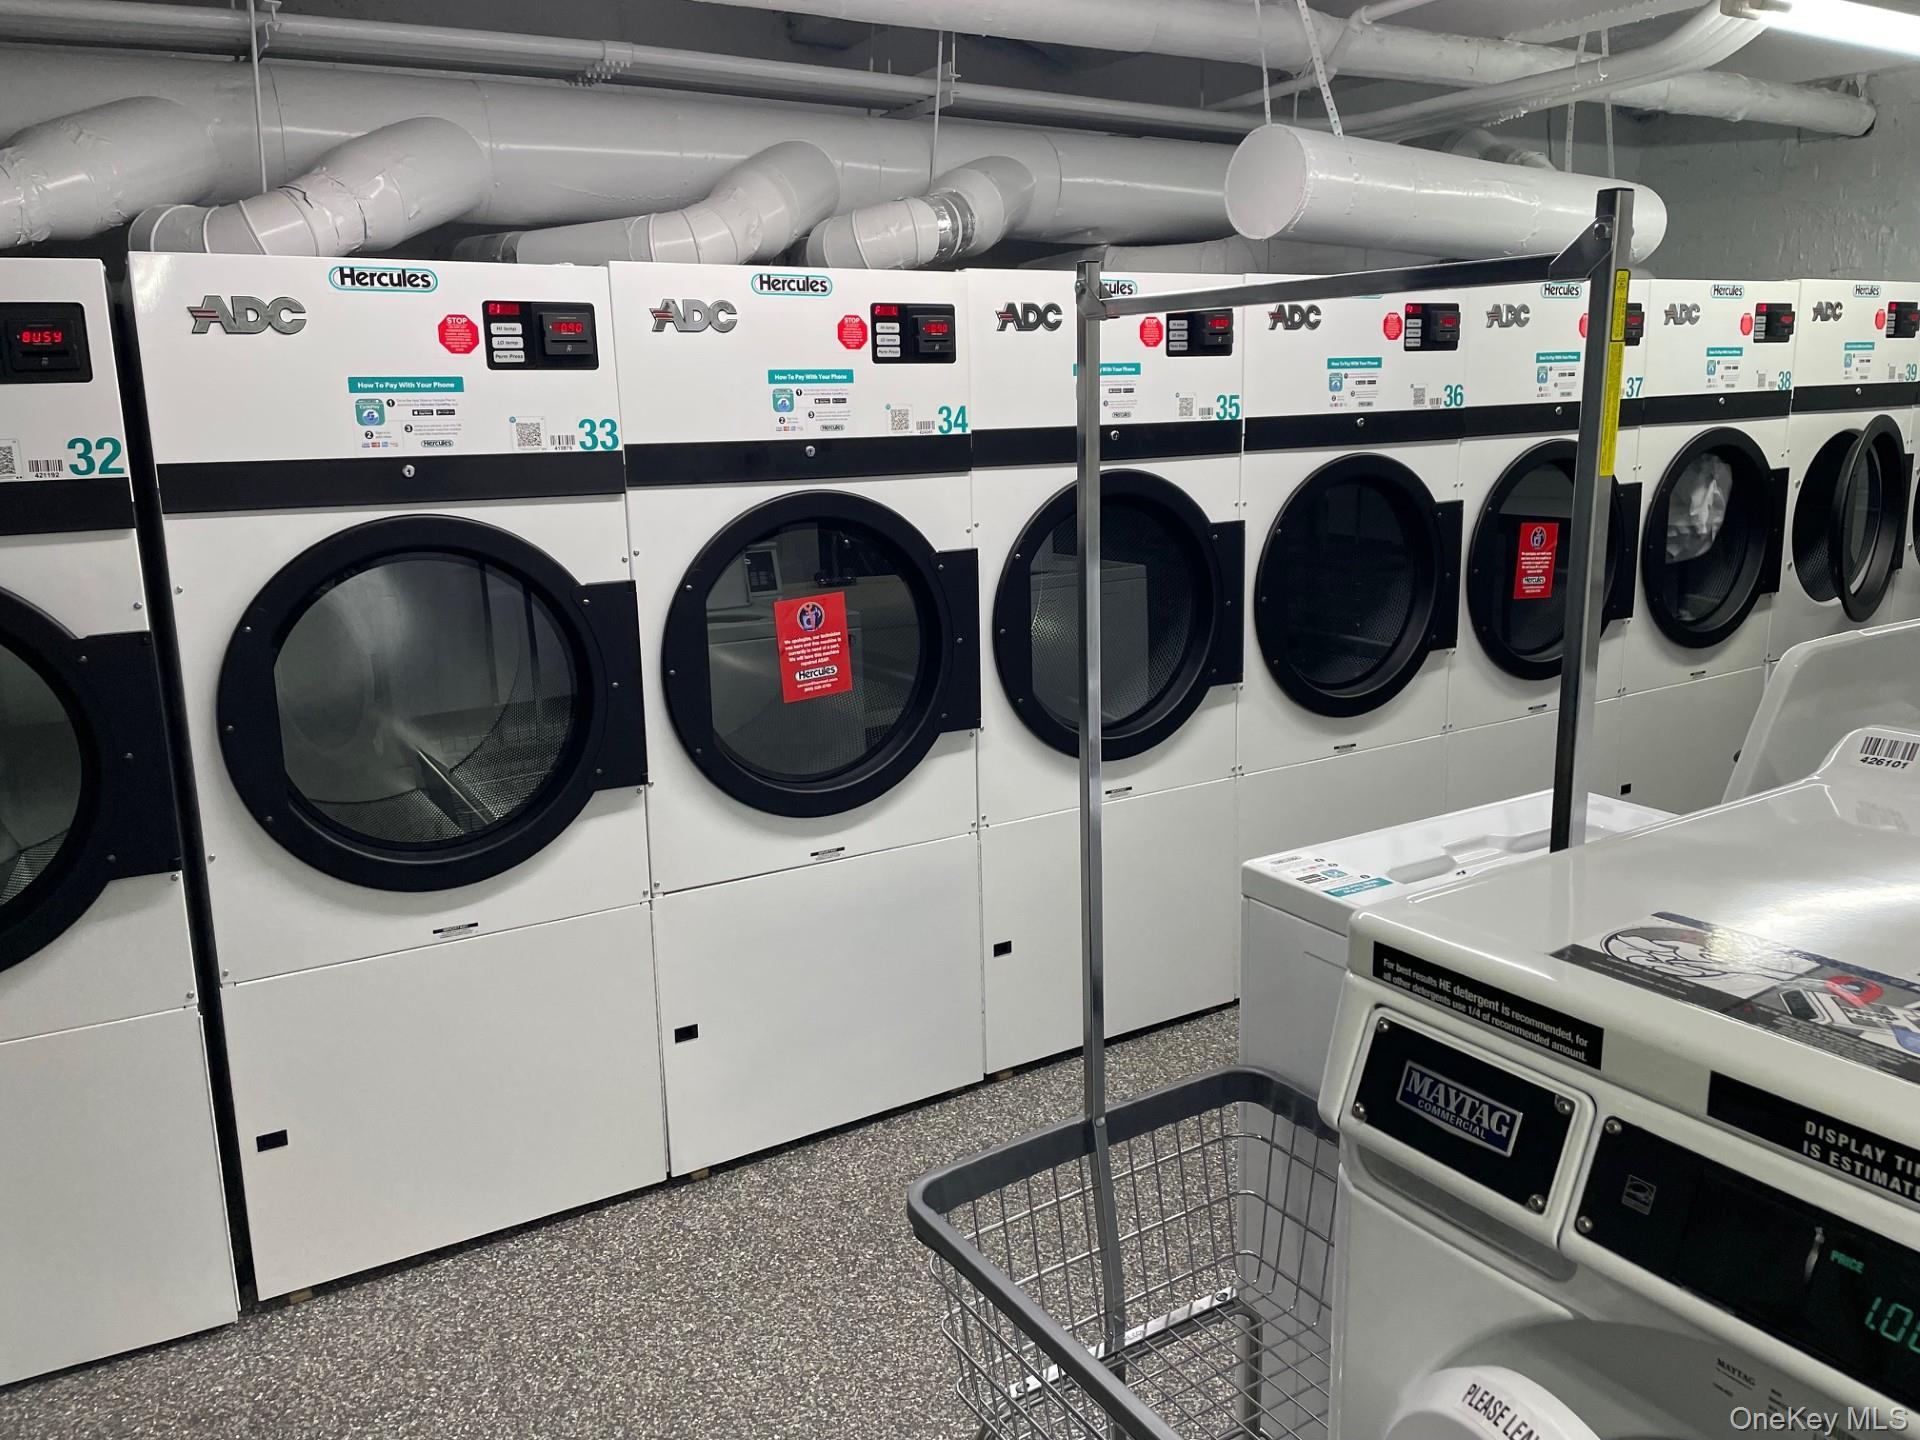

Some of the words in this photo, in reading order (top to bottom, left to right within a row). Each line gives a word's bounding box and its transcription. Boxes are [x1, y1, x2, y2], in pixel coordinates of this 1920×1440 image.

[338, 267, 432, 289] Hercules
[758, 275, 828, 293] Hercules
[1544, 284, 1580, 296] Hercules
[1713, 285, 1743, 296] Hercules
[1855, 285, 1880, 296] Hercules
[187, 295, 307, 335] ADC
[649, 298, 738, 333] ADC
[995, 302, 1064, 332] ADC
[1267, 303, 1322, 331] ADC
[1486, 303, 1531, 328] ADC
[1664, 303, 1701, 326] ADC
[1812, 301, 1843, 322] ADC
[22, 331, 62, 343] BUSY
[1778, 371, 1792, 390] 38
[1905, 364, 1918, 382] 39
[385, 382, 398, 390] Pay
[1443, 384, 1464, 407] 36
[1626, 377, 1643, 398] 37
[938, 405, 969, 434] 34
[1216, 394, 1240, 421] 35
[578, 418, 619, 450] 33
[67, 437, 125, 476] 32
[799, 667, 836, 680] Hercules
[1860, 756, 1909, 769] 426101
[1383, 958, 1396, 970] For
[1396, 962, 1412, 978] best
[1412, 968, 1438, 988] results
[1438, 978, 1452, 994] HE
[1453, 984, 1500, 1013] detergent
[1501, 1002, 1511, 1017] is
[1511, 1010, 1574, 1043] recommended,
[1576, 1034, 1589, 1048] for
[1383, 971, 1392, 982] all
[1392, 974, 1411, 990] other
[1412, 982, 1451, 1007] detergents
[1452, 1001, 1467, 1013] use
[1468, 1005, 1481, 1019] 1/4
[1482, 1011, 1490, 1022] of
[1491, 1016, 1550, 1046] recommended
[1551, 1041, 1588, 1063] amount.
[1405, 1069, 1511, 1137] MAYTAG
[1418, 1099, 1487, 1140] COMMERCIAL
[1802, 1140, 1822, 1159] IS
[1804, 1120, 1887, 1164] DISPLAY
[1829, 1249, 1865, 1275] PRICE
[1717, 1358, 1756, 1386] MAYTAG
[1462, 1383, 1511, 1427] PLEASE
[1502, 1413, 1543, 1440] LEA
